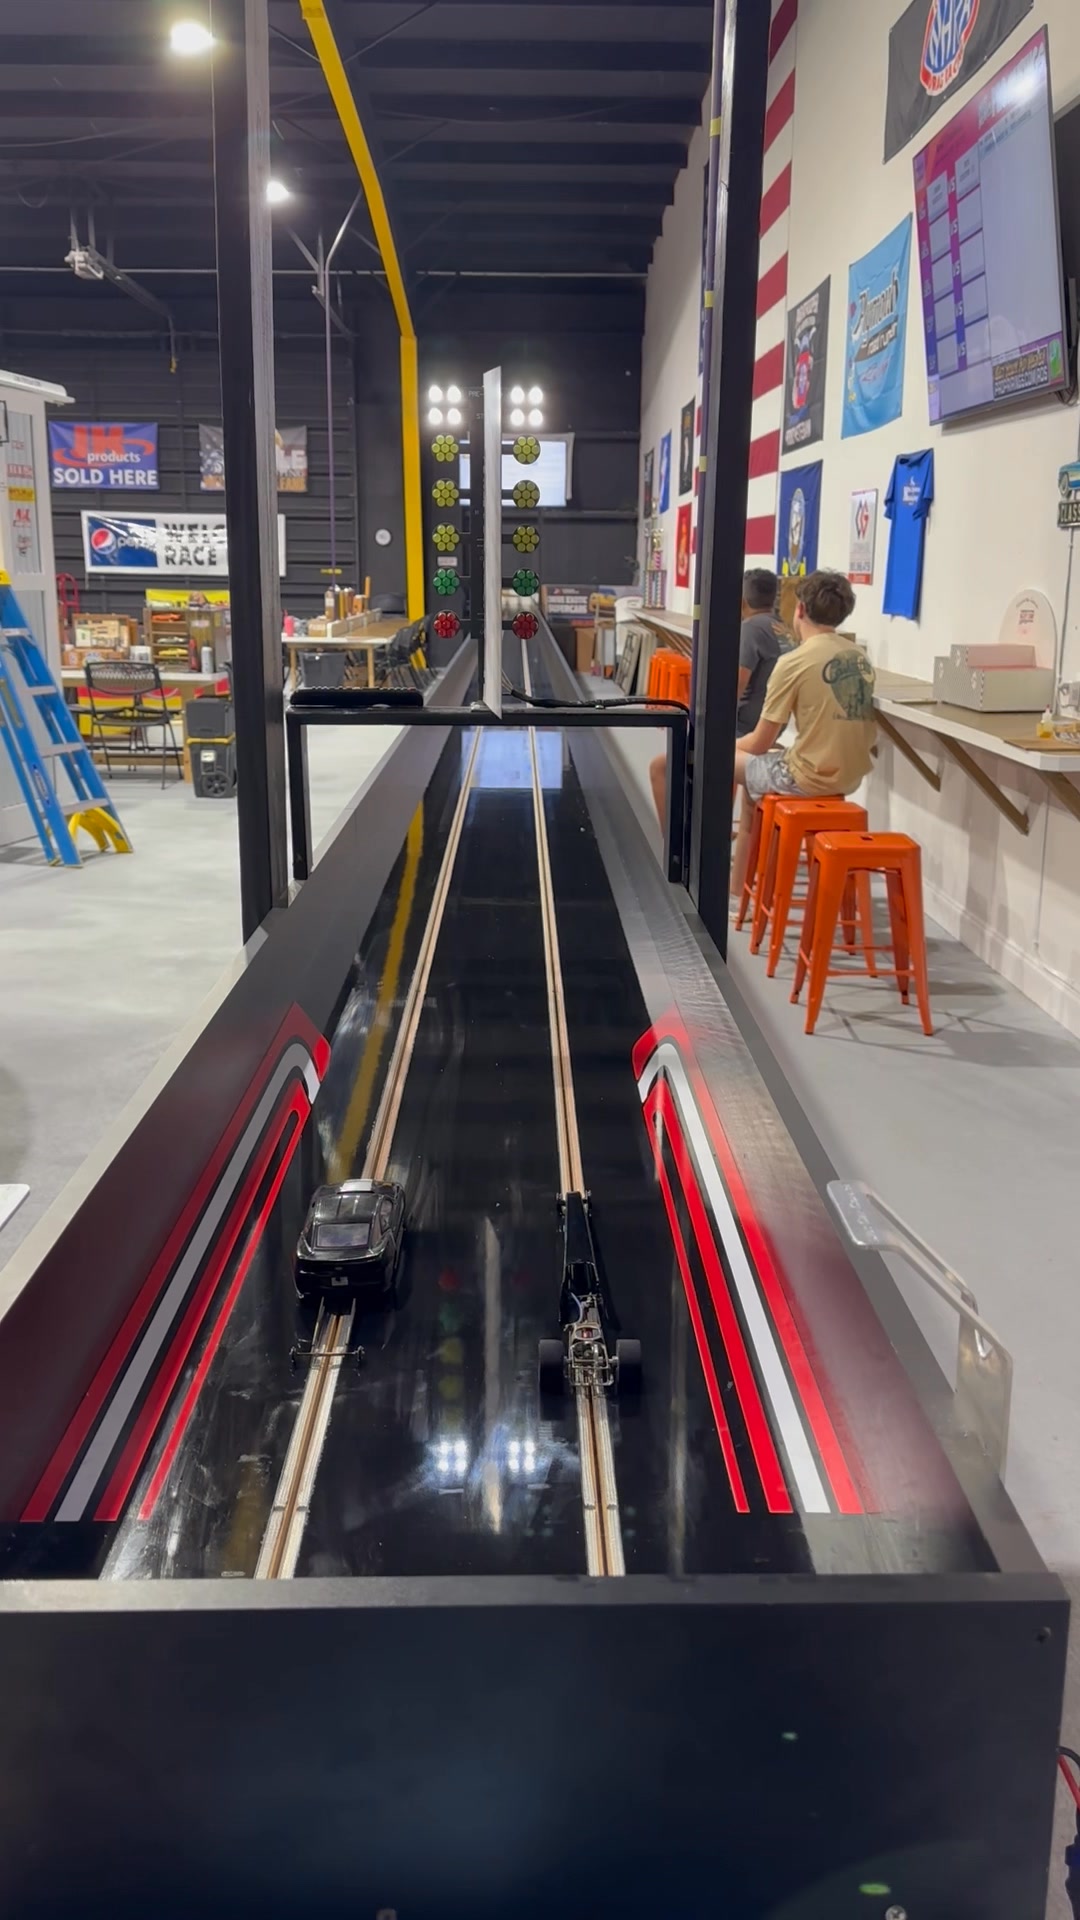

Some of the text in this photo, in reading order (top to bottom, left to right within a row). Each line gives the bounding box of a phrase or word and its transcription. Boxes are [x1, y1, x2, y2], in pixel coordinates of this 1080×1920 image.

[87, 450, 141, 465] products
[53, 468, 157, 485] SOLD HERE
[165, 545, 217, 566] RACE
